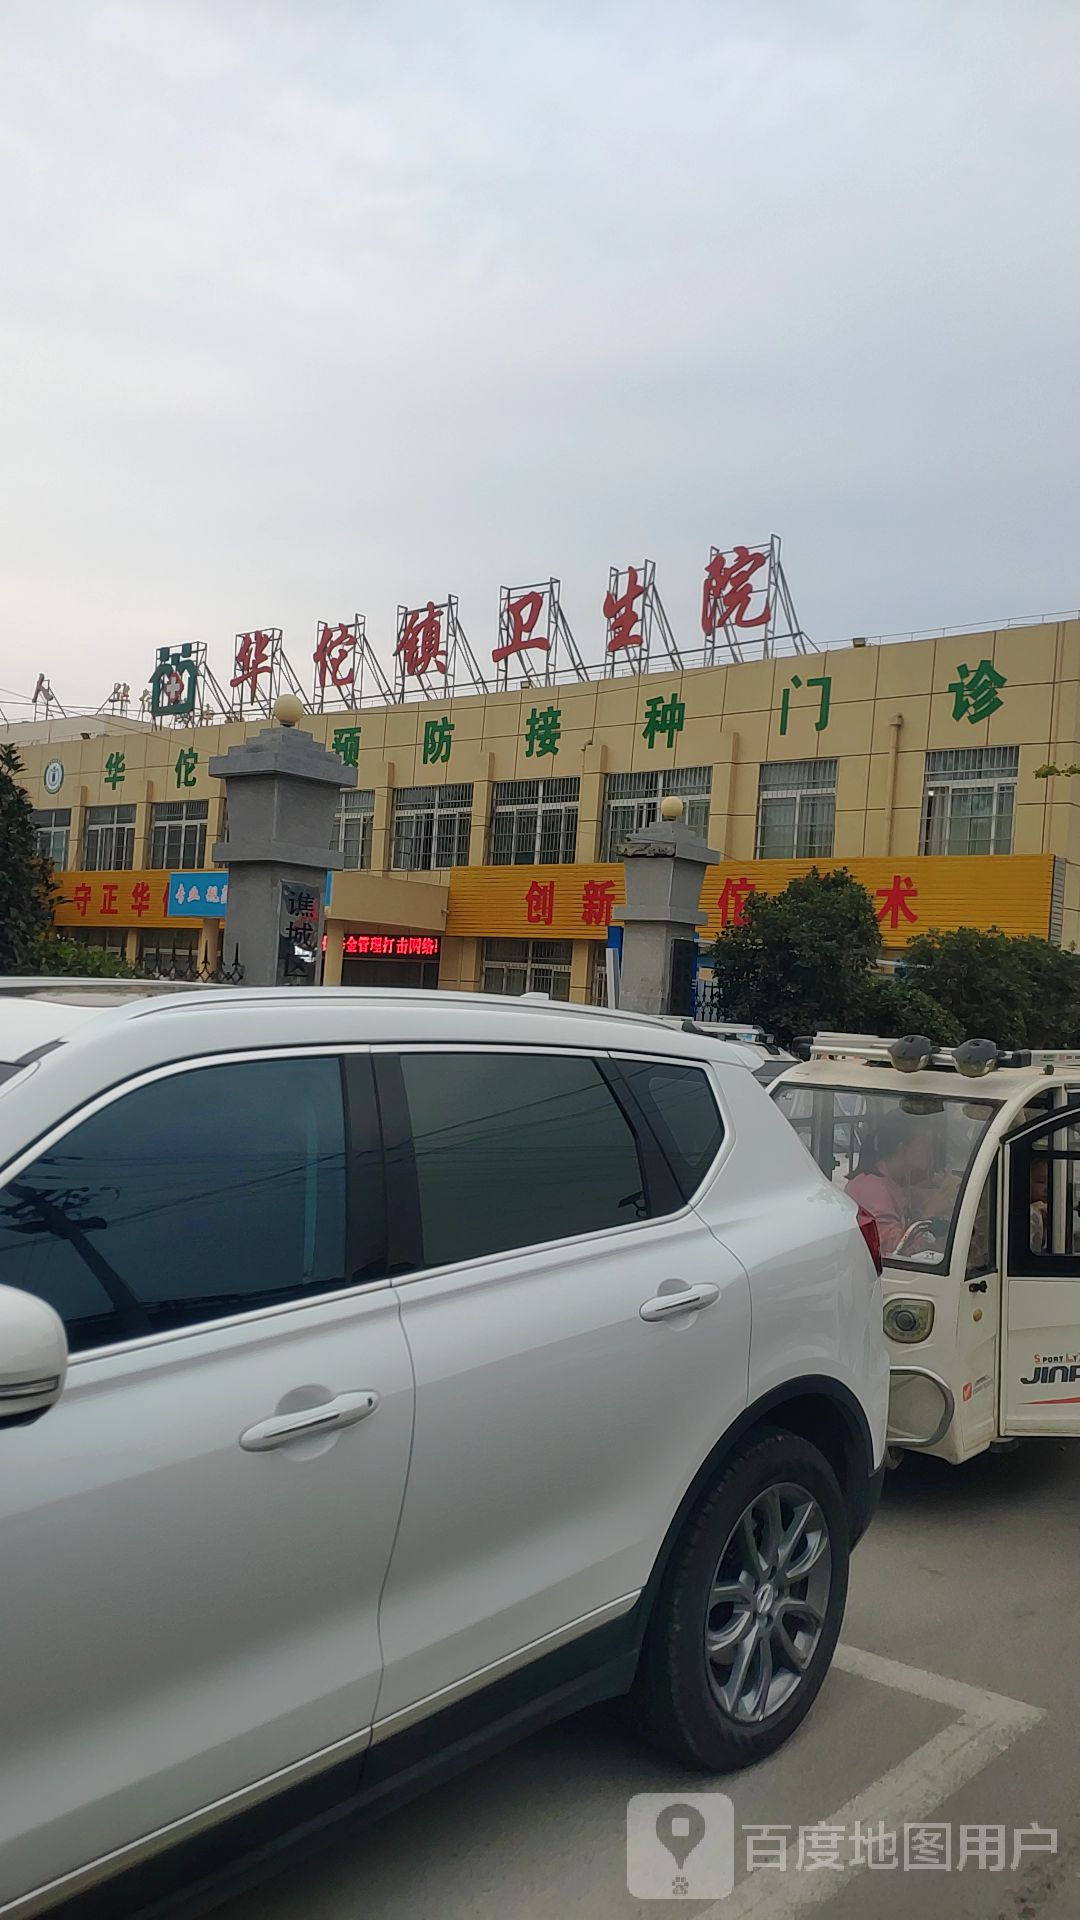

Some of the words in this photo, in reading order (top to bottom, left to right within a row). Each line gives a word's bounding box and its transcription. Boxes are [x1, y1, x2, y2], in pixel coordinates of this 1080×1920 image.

[230, 546, 772, 705] 华佗镇卫生院
[74, 882, 169, 917] 守正华
